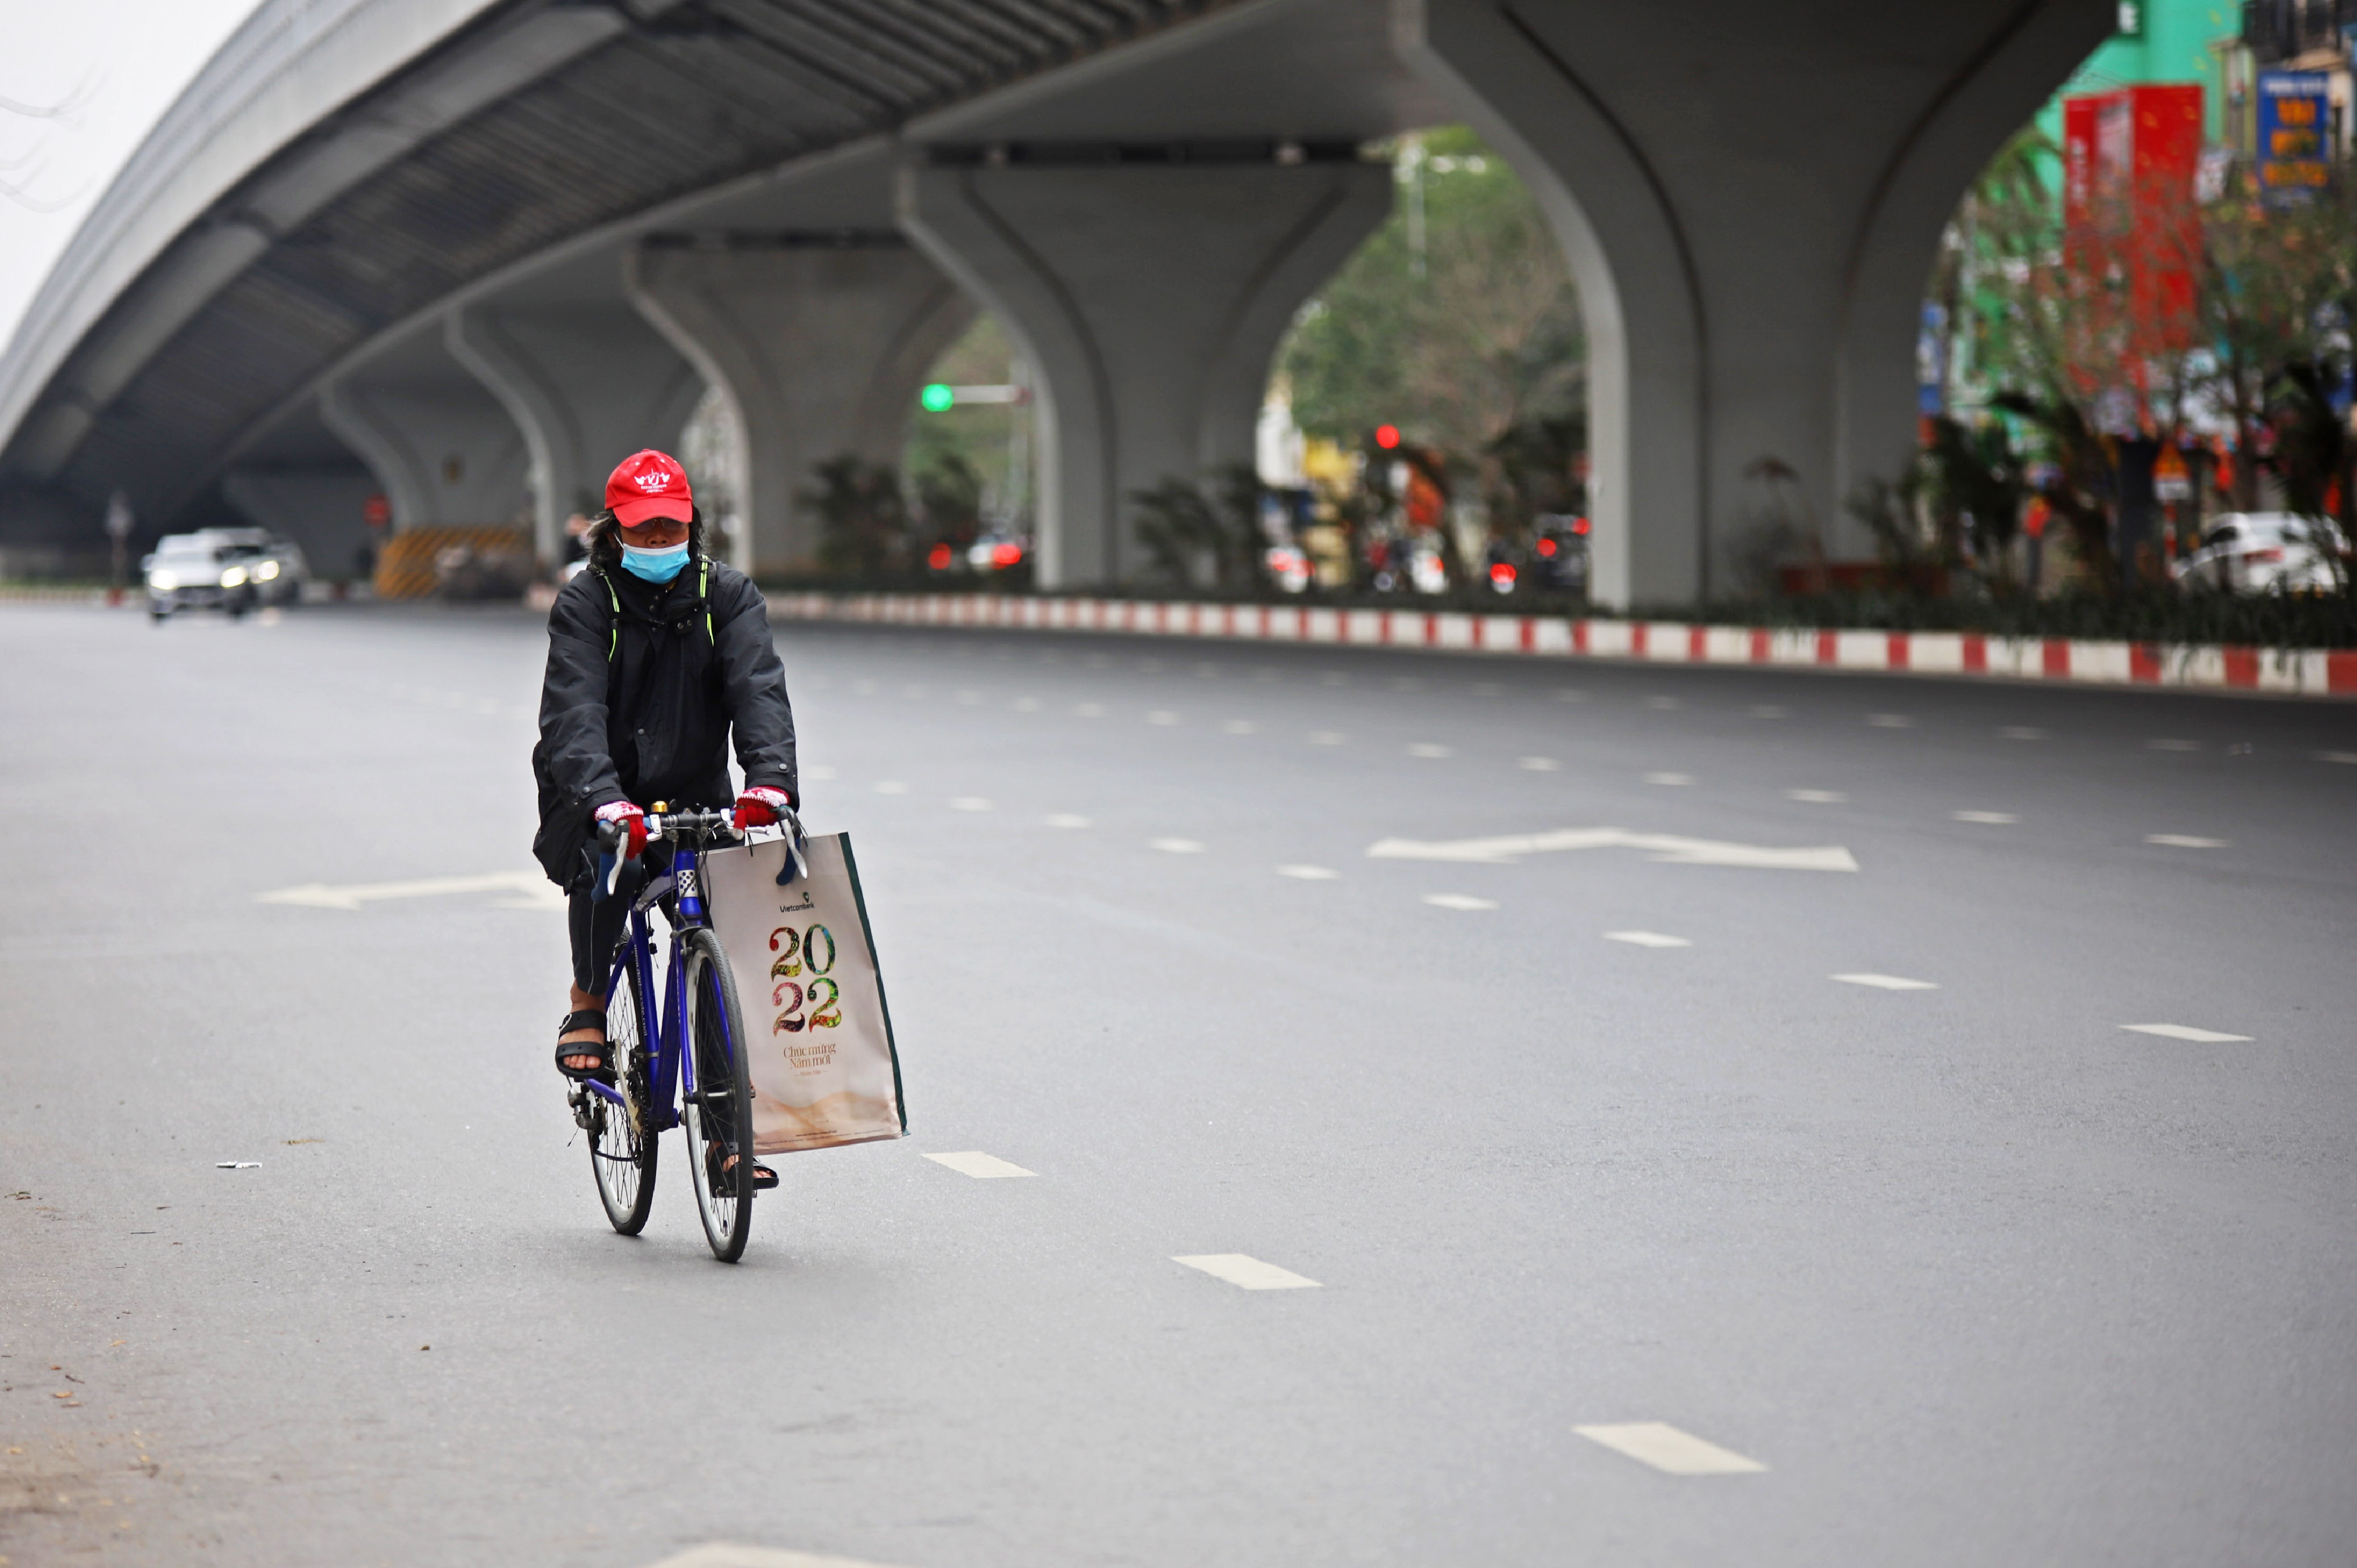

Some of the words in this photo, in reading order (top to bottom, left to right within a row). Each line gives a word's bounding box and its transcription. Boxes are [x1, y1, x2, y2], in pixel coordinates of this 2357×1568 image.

[780, 902, 815, 913] Vietcombank
[769, 923, 836, 982] 20
[772, 977, 842, 1037] 22
[784, 1046, 807, 1058] Chúc
[808, 1042, 836, 1055] mừng
[790, 1058, 810, 1070] Năm
[812, 1054, 831, 1066] mới
